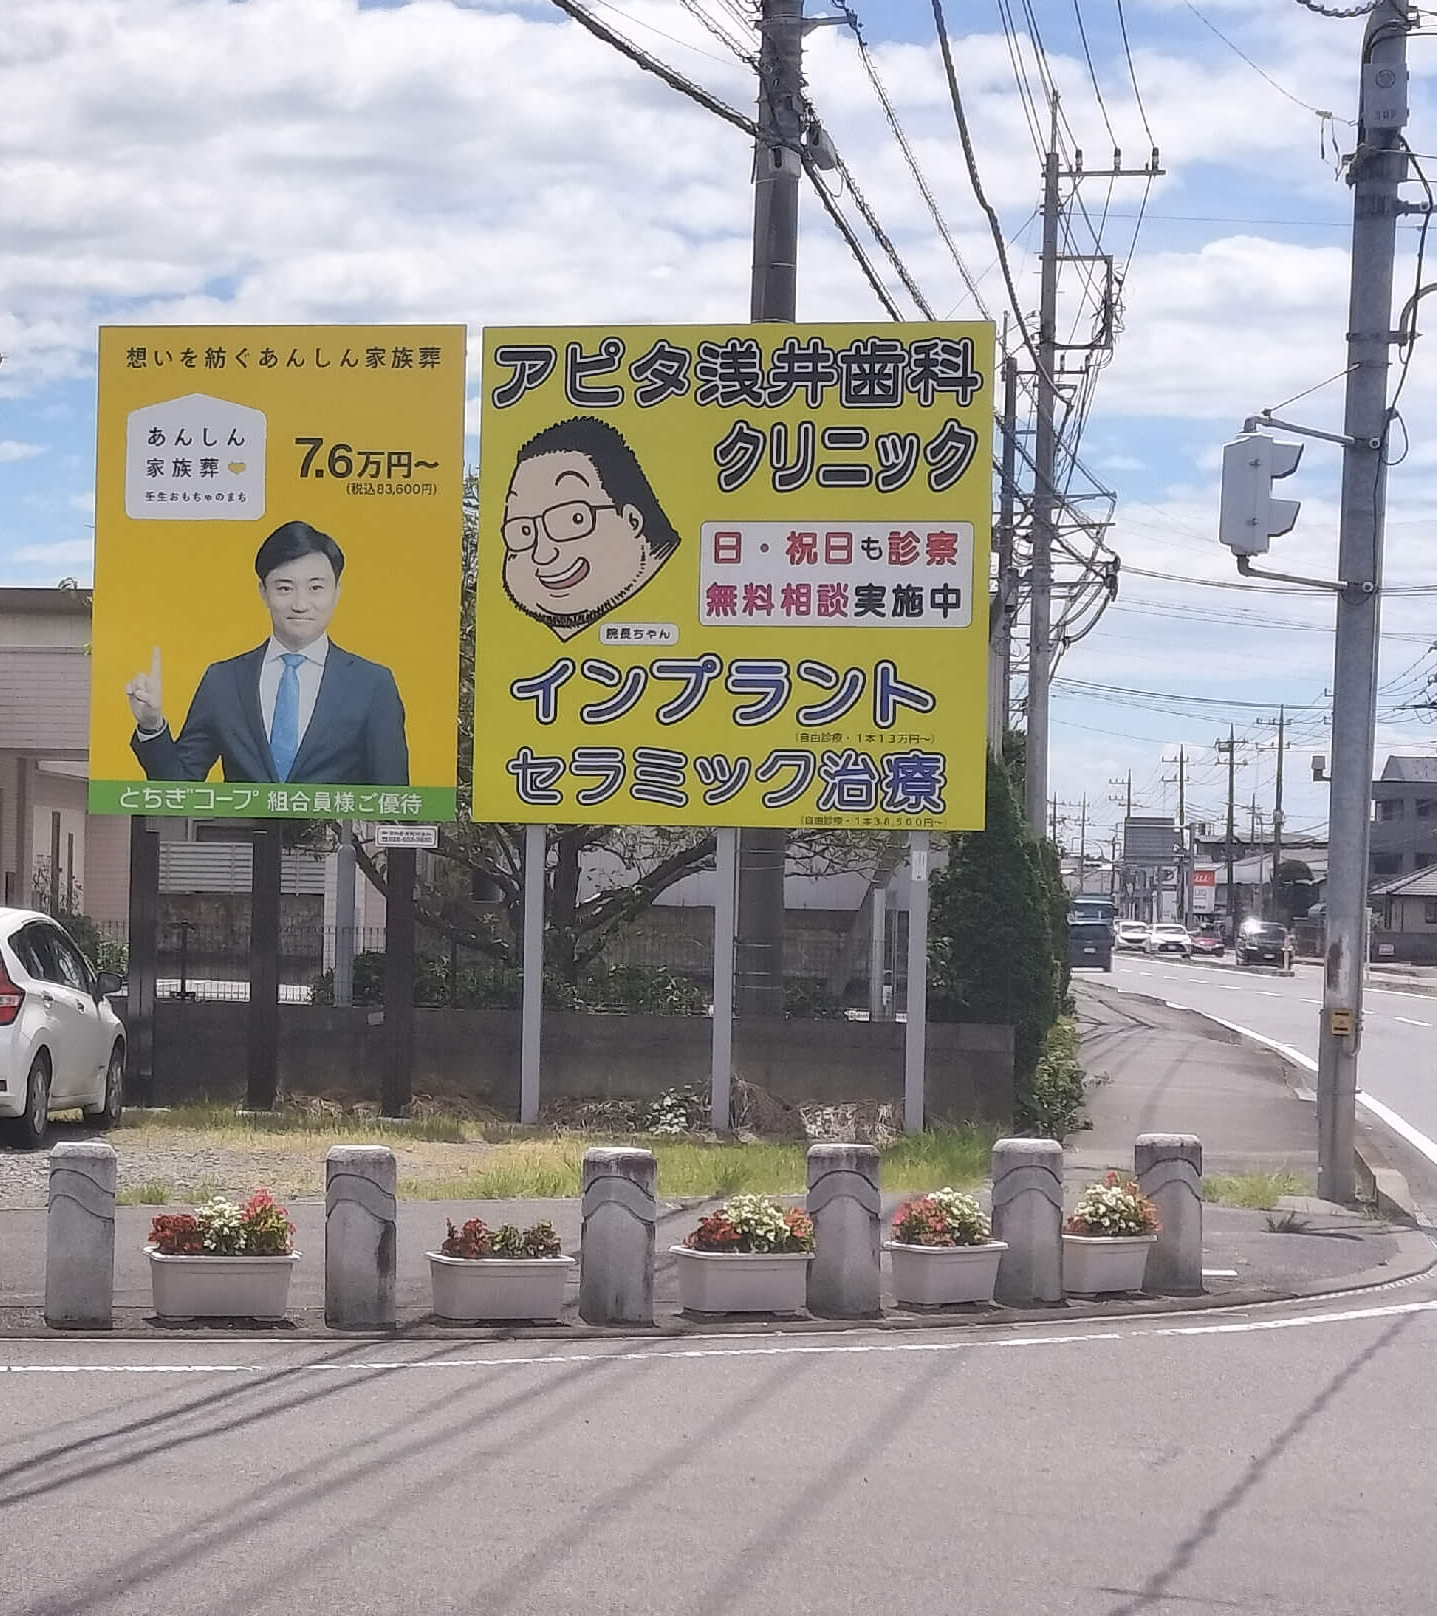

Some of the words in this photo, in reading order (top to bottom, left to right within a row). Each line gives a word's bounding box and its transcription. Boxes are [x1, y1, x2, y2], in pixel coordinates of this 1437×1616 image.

[125, 346, 444, 370] 想いを紡ぐあんしん家族葬
[491, 336, 984, 409] アピタ浅井歯科
[146, 426, 247, 447] あんしん
[145, 457, 221, 479] 家族葬
[714, 418, 978, 494] クリニック
[713, 531, 959, 567] 日・祝日も診察
[705, 582, 963, 619] 無料相談実施中
[605, 627, 671, 640] 院長ちゃん
[509, 652, 937, 728] インプラント
[505, 746, 948, 814] セラミック治療
[266, 790, 423, 815] 組合員様ご優待
